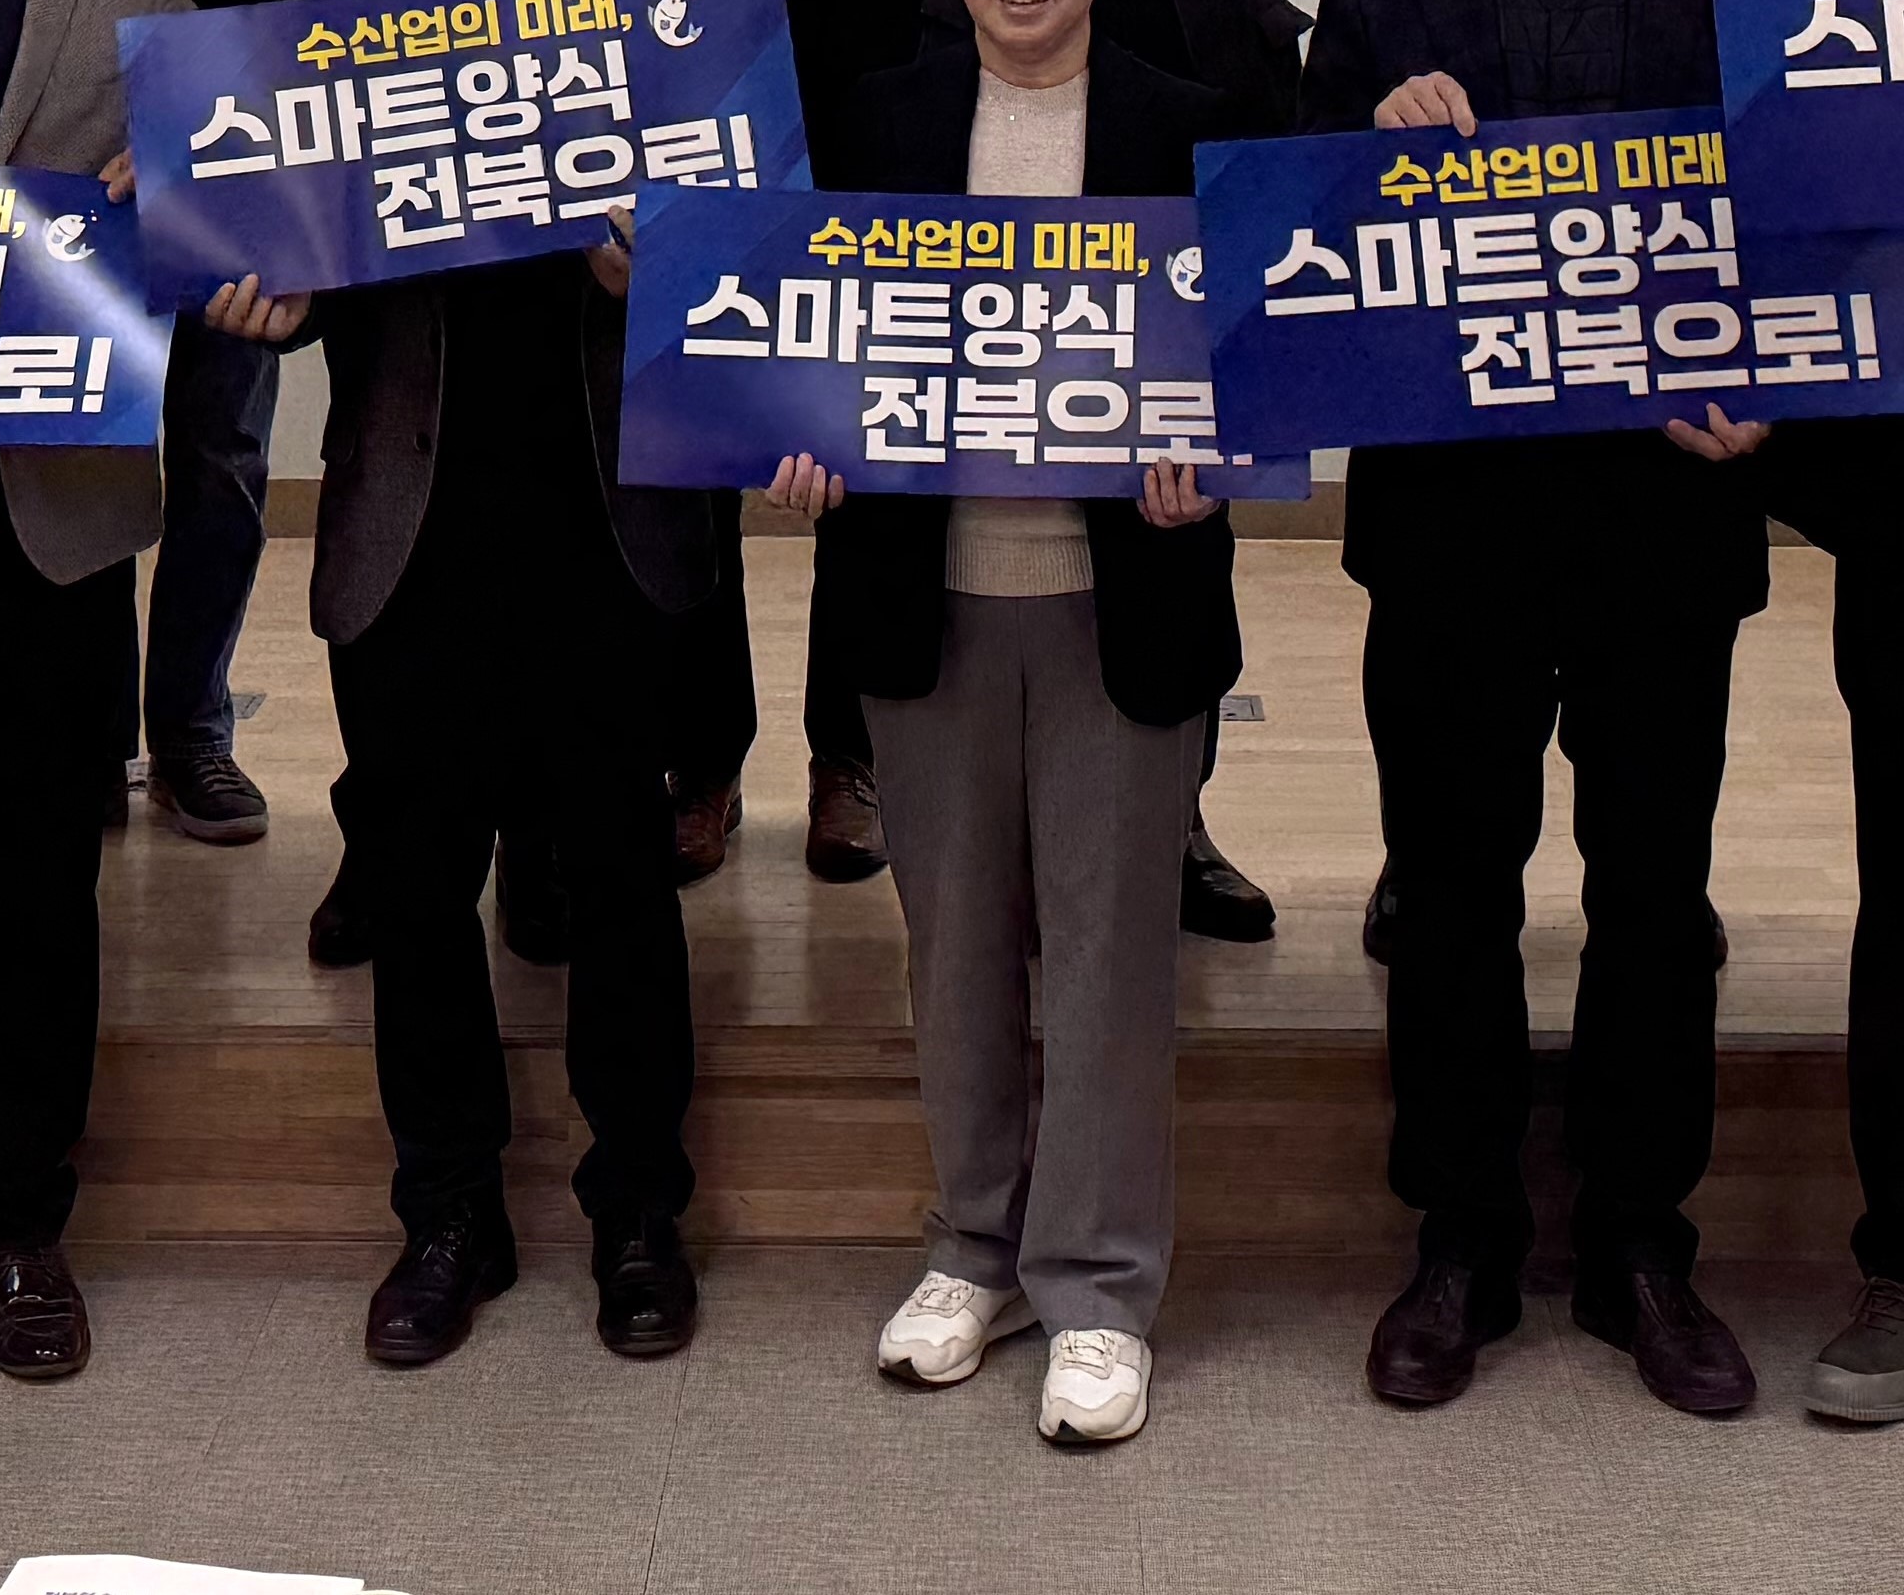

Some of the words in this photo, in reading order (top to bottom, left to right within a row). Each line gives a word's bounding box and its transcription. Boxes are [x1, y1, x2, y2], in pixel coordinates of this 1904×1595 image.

[296, 0, 501, 71] 수산업의
[190, 39, 632, 180] 스마트양식
[372, 113, 758, 249] 전북으로!
[1380, 140, 1598, 207] 수산업의
[1614, 131, 1727, 191] 미래
[808, 216, 1015, 271] 수산업의
[1033, 221, 1149, 277] 미래,
[1263, 196, 1740, 316] 스마트양식
[682, 274, 1135, 369] 스마트양식
[1458, 293, 1881, 407] 전북으로!
[861, 376, 1254, 466] 전북으로
